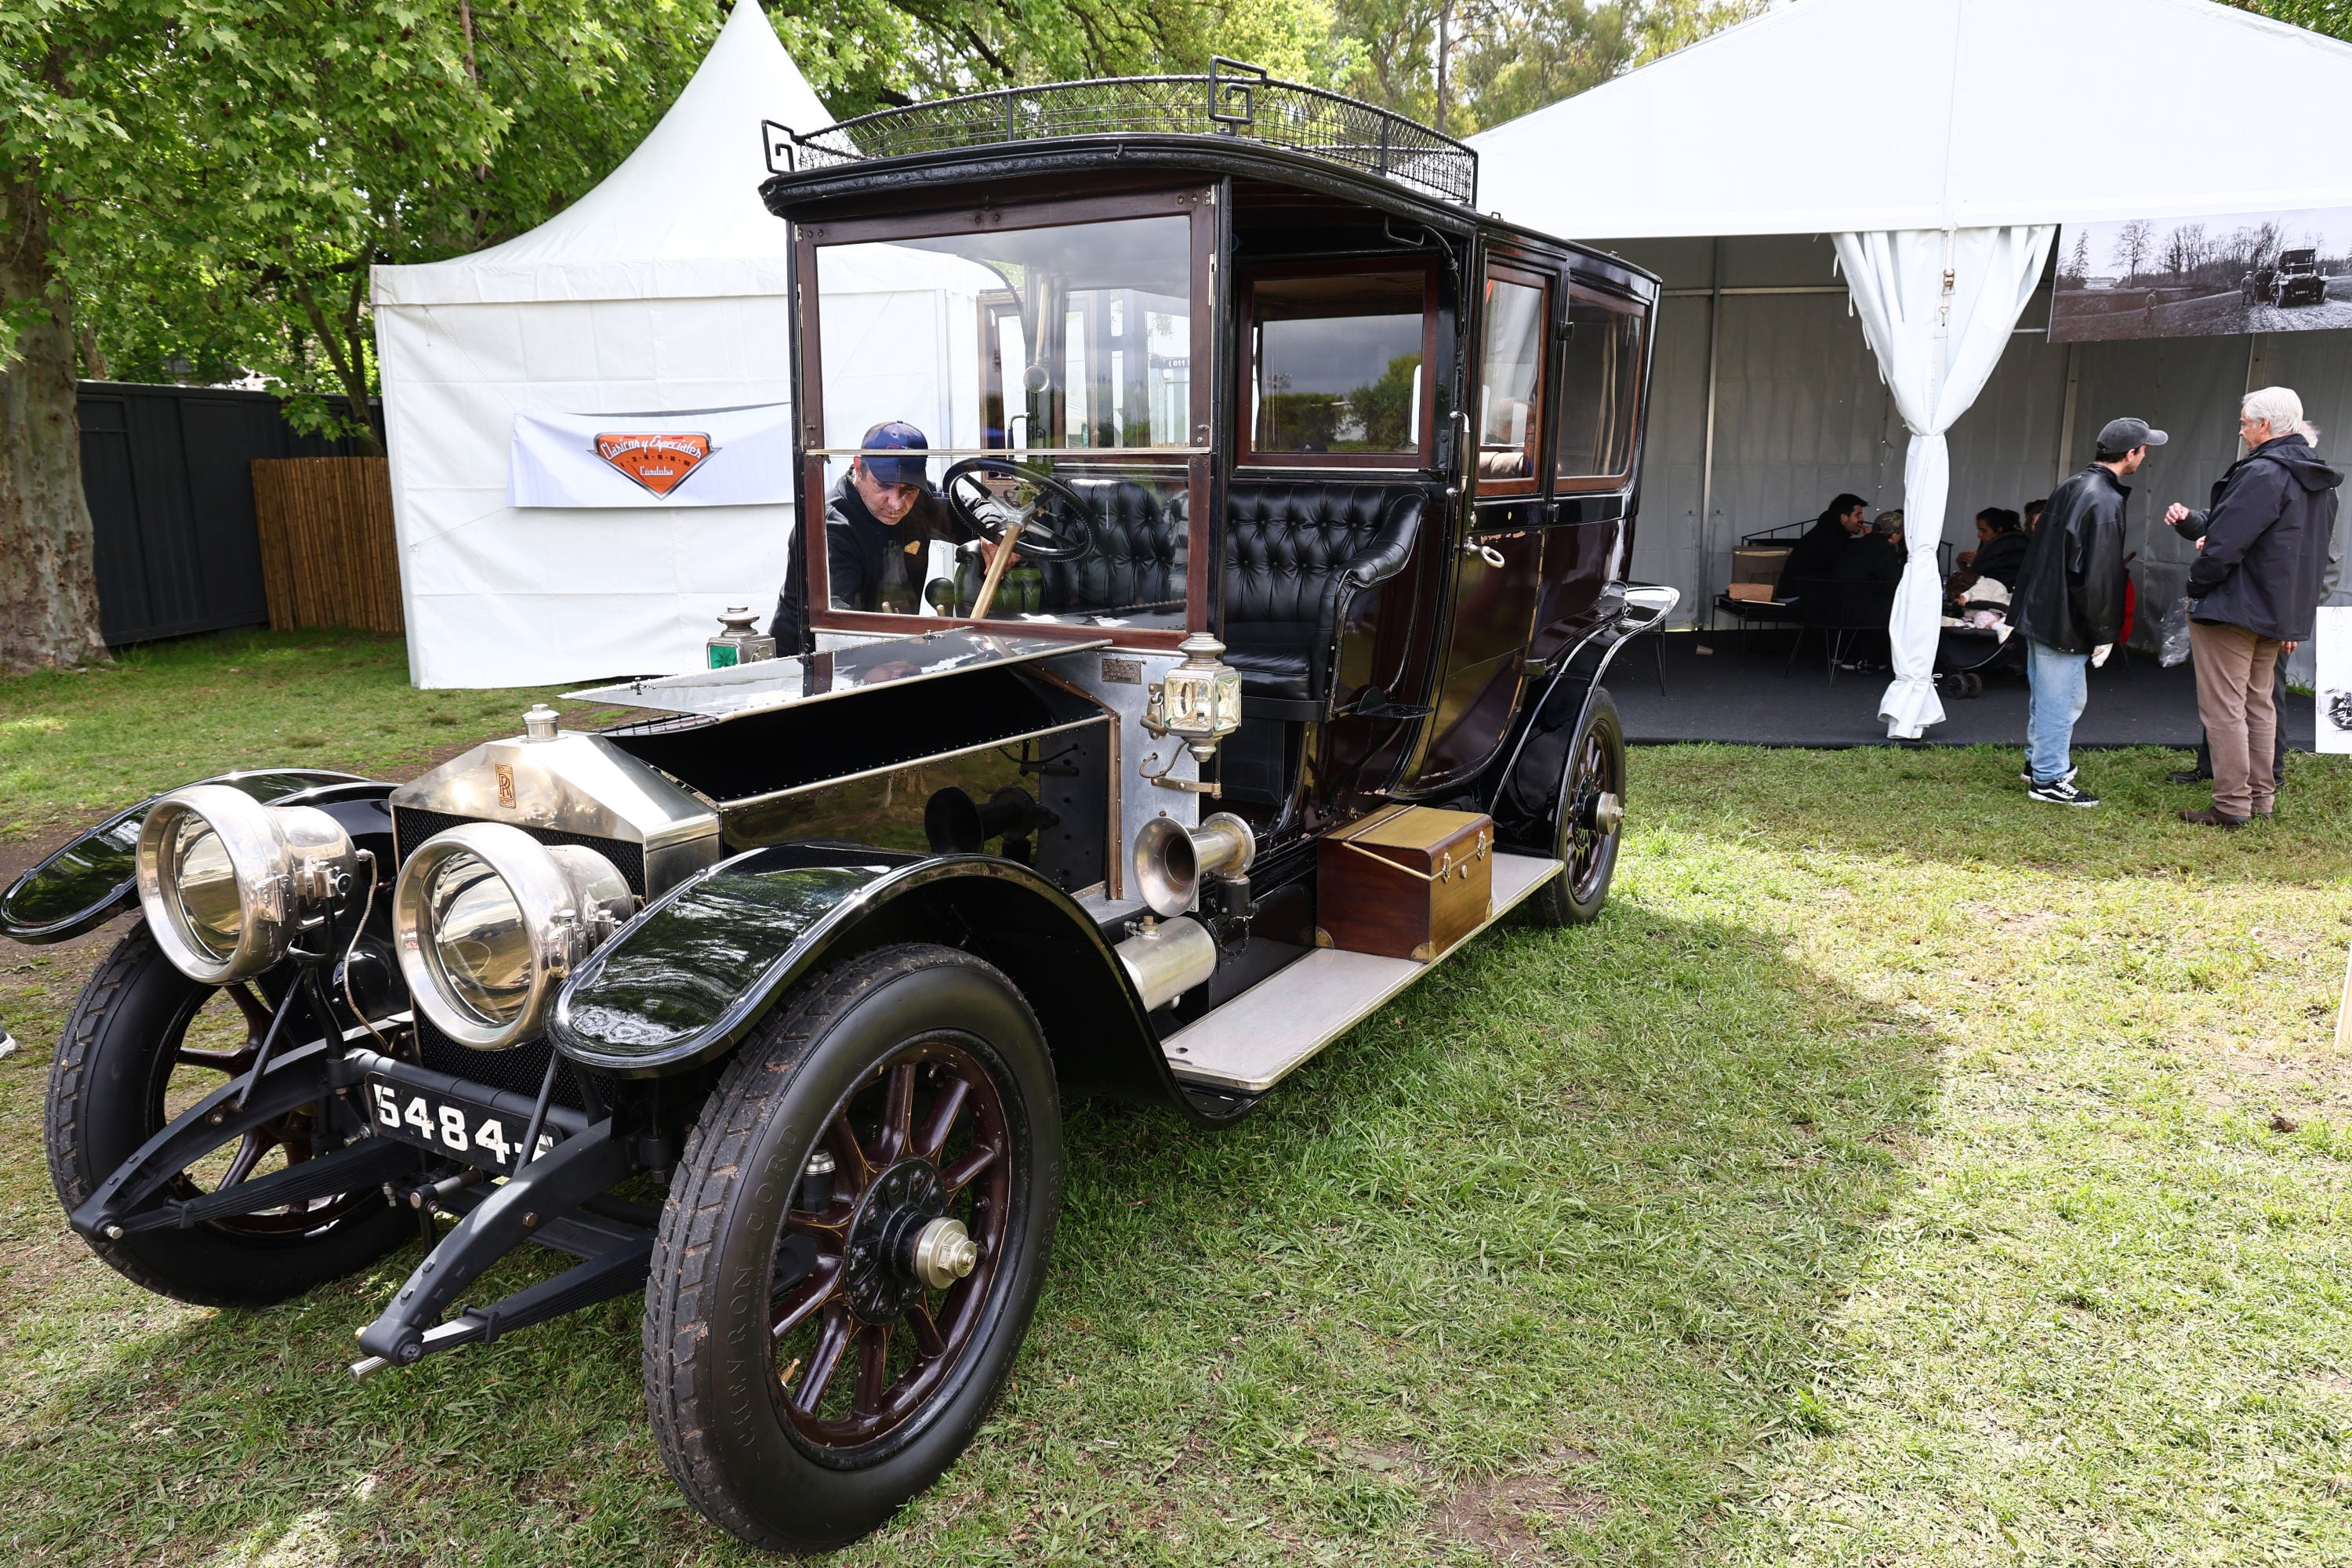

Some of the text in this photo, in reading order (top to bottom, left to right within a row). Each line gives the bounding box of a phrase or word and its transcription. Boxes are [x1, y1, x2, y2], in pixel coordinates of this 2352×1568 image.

[641, 439, 648, 453] y
[649, 435, 702, 459] Especiales
[746, 1123, 799, 1236] CORD
